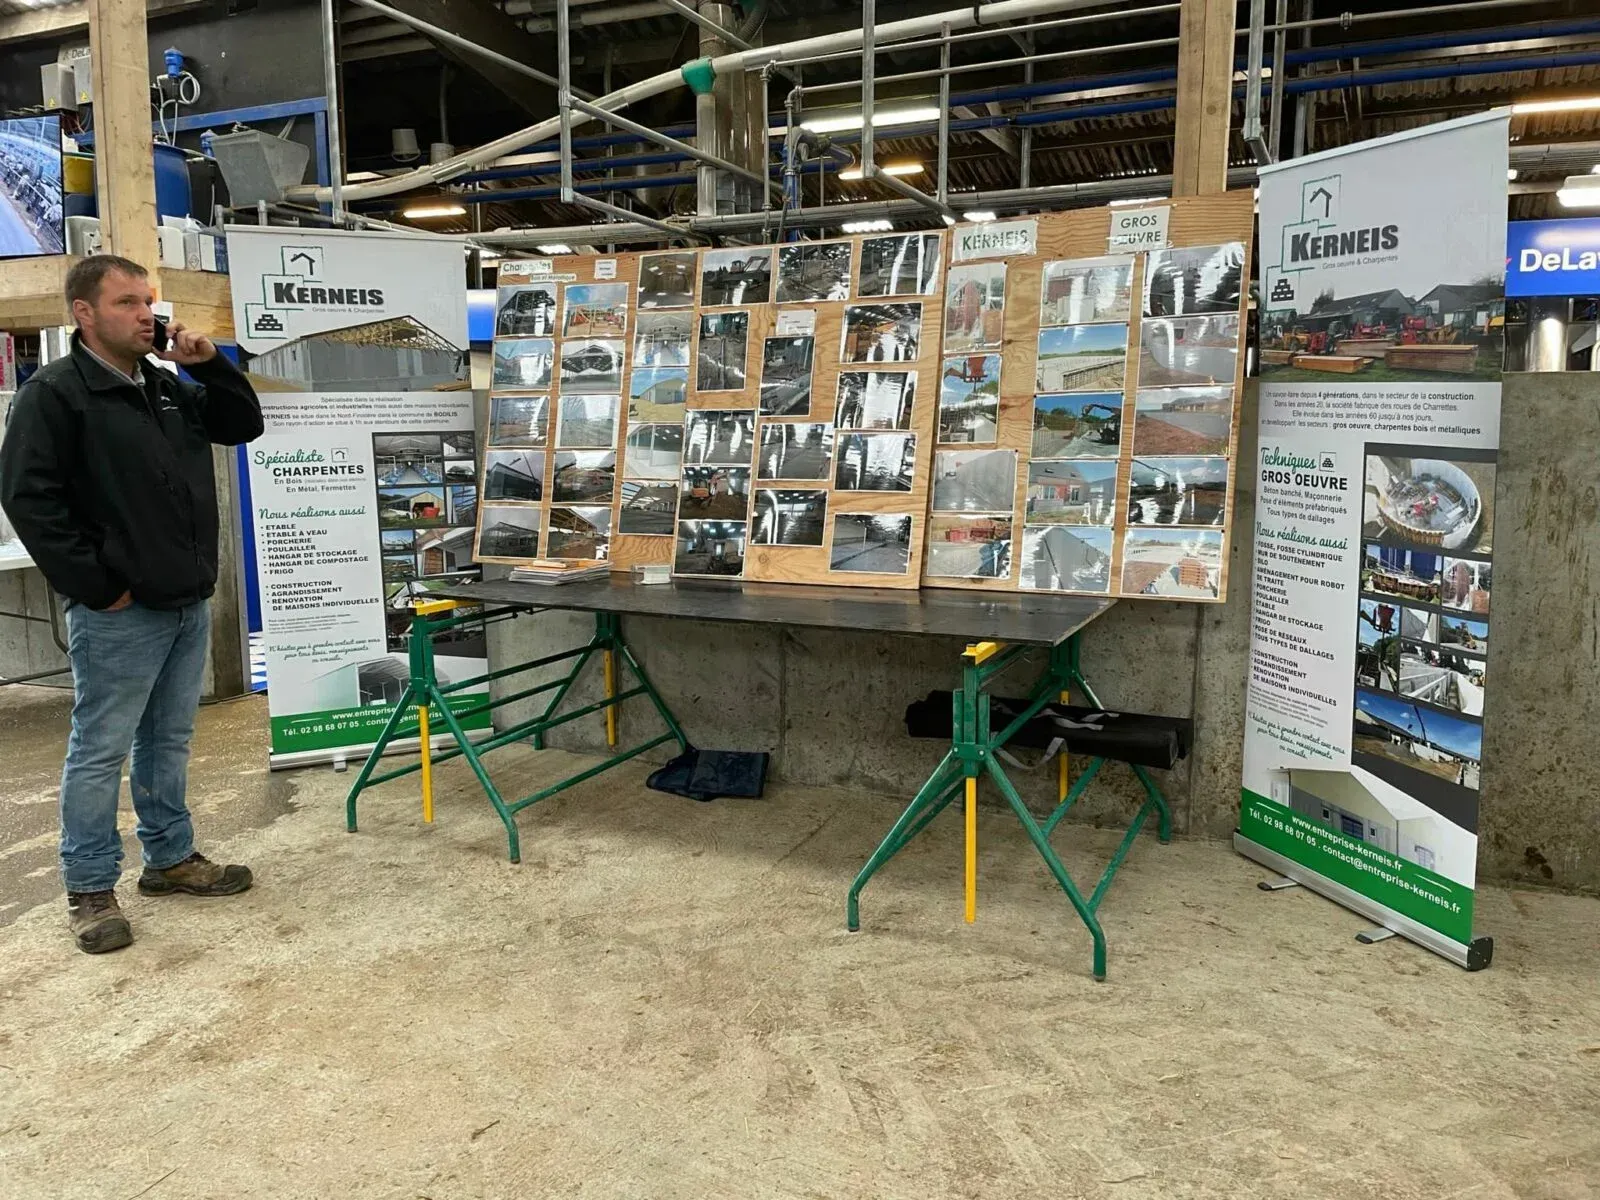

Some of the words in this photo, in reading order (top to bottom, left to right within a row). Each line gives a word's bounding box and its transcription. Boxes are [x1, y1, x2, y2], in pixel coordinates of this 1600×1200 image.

[1120, 215, 1158, 228] GROS
[962, 229, 1028, 251] KERNEIS
[1290, 224, 1399, 263] KERNEIS
[1362, 255, 1399, 266] Charpentes
[1519, 247, 1600, 273] DeLa
[273, 282, 385, 306] KERNEIS
[1386, 392, 1409, 400] secteur
[1428, 392, 1474, 400] construction
[1332, 422, 1347, 430] gros
[1374, 423, 1411, 432] charpentes
[1413, 424, 1428, 432] bois
[1429, 425, 1437, 433] et
[1437, 425, 1481, 436] métalliques
[254, 449, 325, 469] Spécialiste
[1261, 446, 1317, 474] Techniques
[273, 465, 365, 477] CHARPENTES
[1261, 470, 1291, 485] GROS
[1295, 473, 1348, 491] OEUVRE
[1304, 491, 1342, 502] Maçonnerie
[259, 508, 289, 519] Nous
[290, 506, 338, 518] réalisons
[339, 506, 366, 515] aussi
[1267, 507, 1281, 516] Tous
[1282, 510, 1298, 519] types
[1299, 512, 1306, 520] de
[1307, 513, 1335, 525] dallages
[1256, 521, 1275, 538] Nous
[1277, 526, 1317, 546] réalisons
[1319, 538, 1348, 550] aussi
[267, 545, 316, 553] POULAILLER
[316, 549, 358, 558] STOCKAGE
[1269, 551, 1278, 559] DE
[1277, 545, 1296, 554] FOSSE
[1296, 549, 1343, 562] CYLINDRIQUE
[269, 560, 303, 568] HANGAR
[316, 556, 369, 565] COMPOSTAGE
[1257, 557, 1269, 566] SILO
[271, 580, 333, 590] CONSTRUCTION
[1264, 576, 1284, 587] TRAITE
[1300, 576, 1319, 586] POUR
[1320, 580, 1345, 590] ROBOT
[271, 586, 343, 597] AGRANDISSEMENT
[1256, 583, 1287, 596] PORCHERIE
[285, 602, 320, 610] MAISONS
[322, 597, 380, 607] INDIVIDUELLES
[1256, 591, 1289, 605] POULAILLER
[1255, 608, 1278, 620] HANGAR
[1279, 614, 1287, 622] DE
[1287, 617, 1324, 631] STOCKAGE
[1255, 616, 1271, 626] FRIGO
[1255, 624, 1268, 634] POSE
[1255, 632, 1269, 643] TOUS
[1270, 637, 1288, 648] TYPES
[1289, 643, 1297, 651] DE
[1299, 646, 1335, 660] DALLAGES
[1253, 649, 1299, 668] CONSTRUCTION
[1253, 657, 1307, 679] AGRANDISSEMENT
[1261, 676, 1287, 691] MAISONS
[1288, 685, 1337, 707] INDIVIDUELLES
[301, 726, 311, 734] 02
[325, 723, 335, 731] 68
[349, 720, 359, 728] 05
[1291, 816, 1403, 872] www.entreprise-kerneis.fr
[1249, 808, 1262, 821] Tél.
[1263, 815, 1272, 826] 02
[1274, 820, 1283, 831] 98
[1285, 825, 1294, 836] 68
[1295, 830, 1305, 840] 07
[1306, 835, 1316, 847] 05
[1322, 844, 1461, 914] contact@entreprise-kerneis.fr
